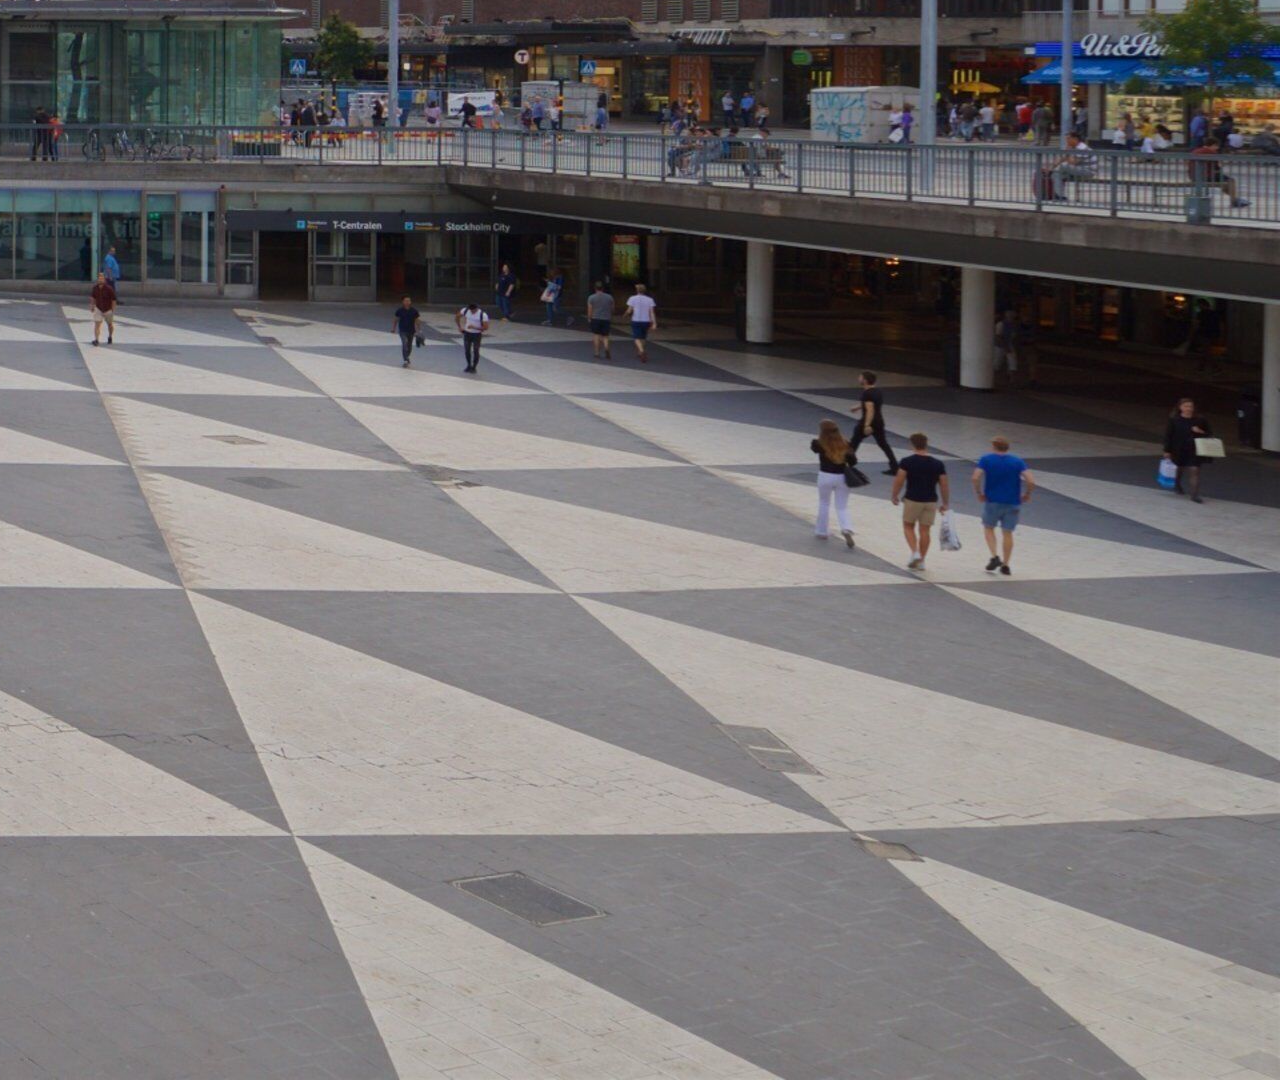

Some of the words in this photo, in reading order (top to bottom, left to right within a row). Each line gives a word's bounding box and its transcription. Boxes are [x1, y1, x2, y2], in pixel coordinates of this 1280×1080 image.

[332, 220, 382, 230] T-Centralen
[446, 221, 492, 232] Stockholm
[493, 222, 511, 233] City
